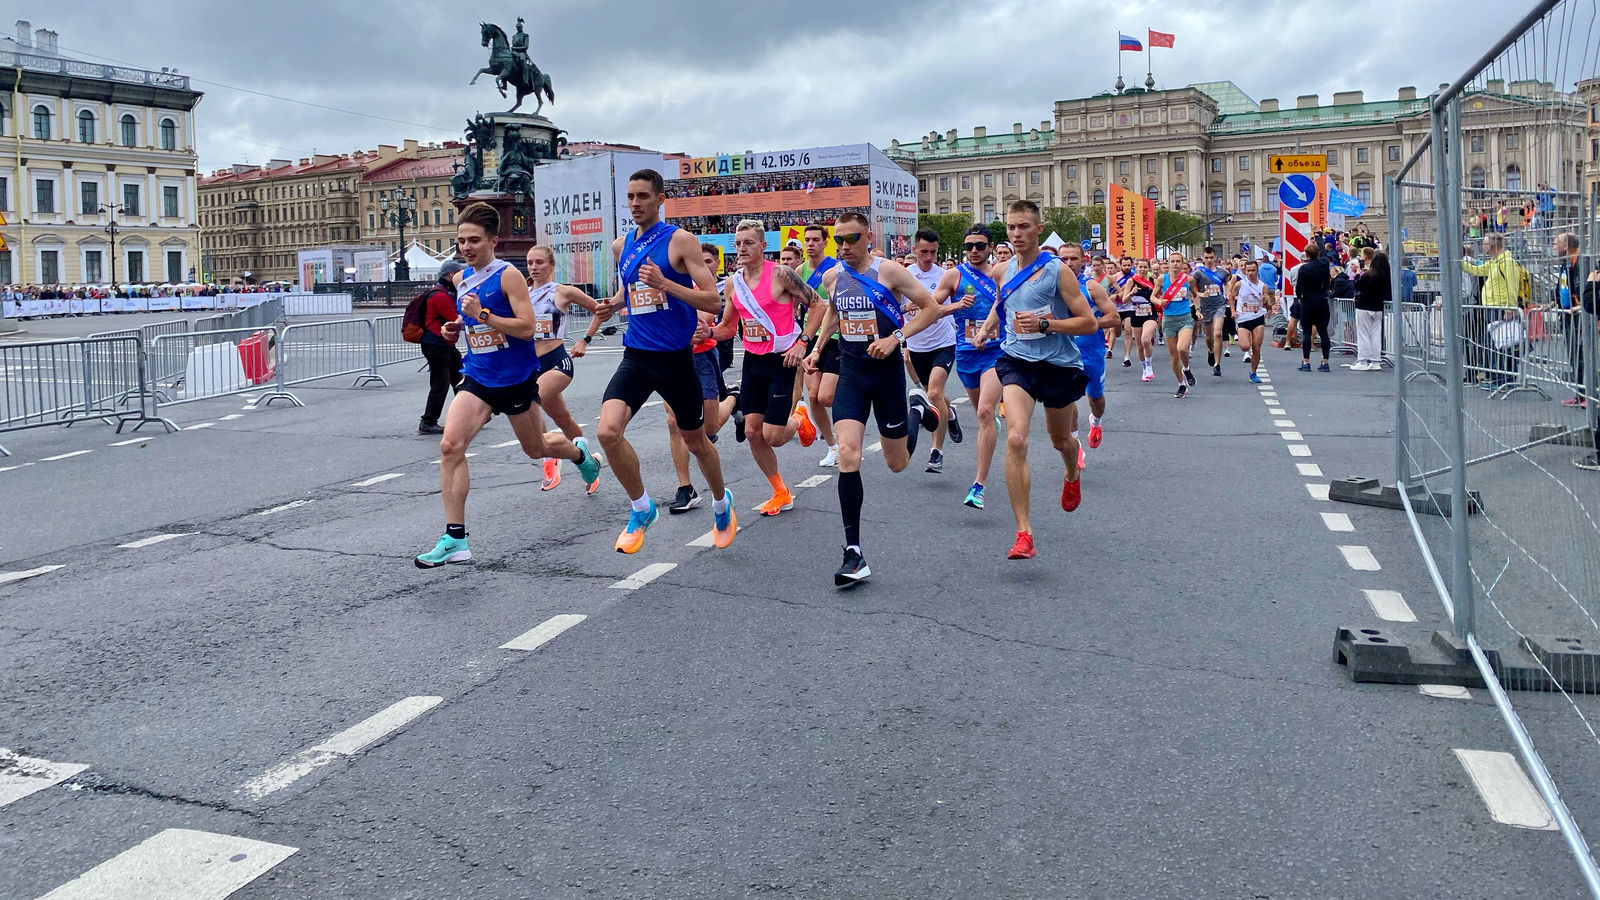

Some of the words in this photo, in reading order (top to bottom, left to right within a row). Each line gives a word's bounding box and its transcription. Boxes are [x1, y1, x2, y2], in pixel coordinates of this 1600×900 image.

[682, 157, 754, 175] ЭКИДЕН
[761, 154, 795, 169] 42.195
[799, 152, 810, 166] /6
[1288, 160, 1321, 168] объезд
[876, 180, 916, 198] ЭКИДЕН
[543, 190, 602, 217] ЭКИДЕН
[545, 221, 562, 236] 42.195
[1116, 196, 1125, 247] ЭКИДЕН
[550, 240, 603, 254] НКТ-ПЕТЕРБУРГ
[632, 291, 664, 306] 155-1
[535, 322, 551, 332] 8-1
[844, 322, 875, 334] 154-1
[970, 327, 998, 338] 1-1
[470, 332, 504, 347] 069-1
